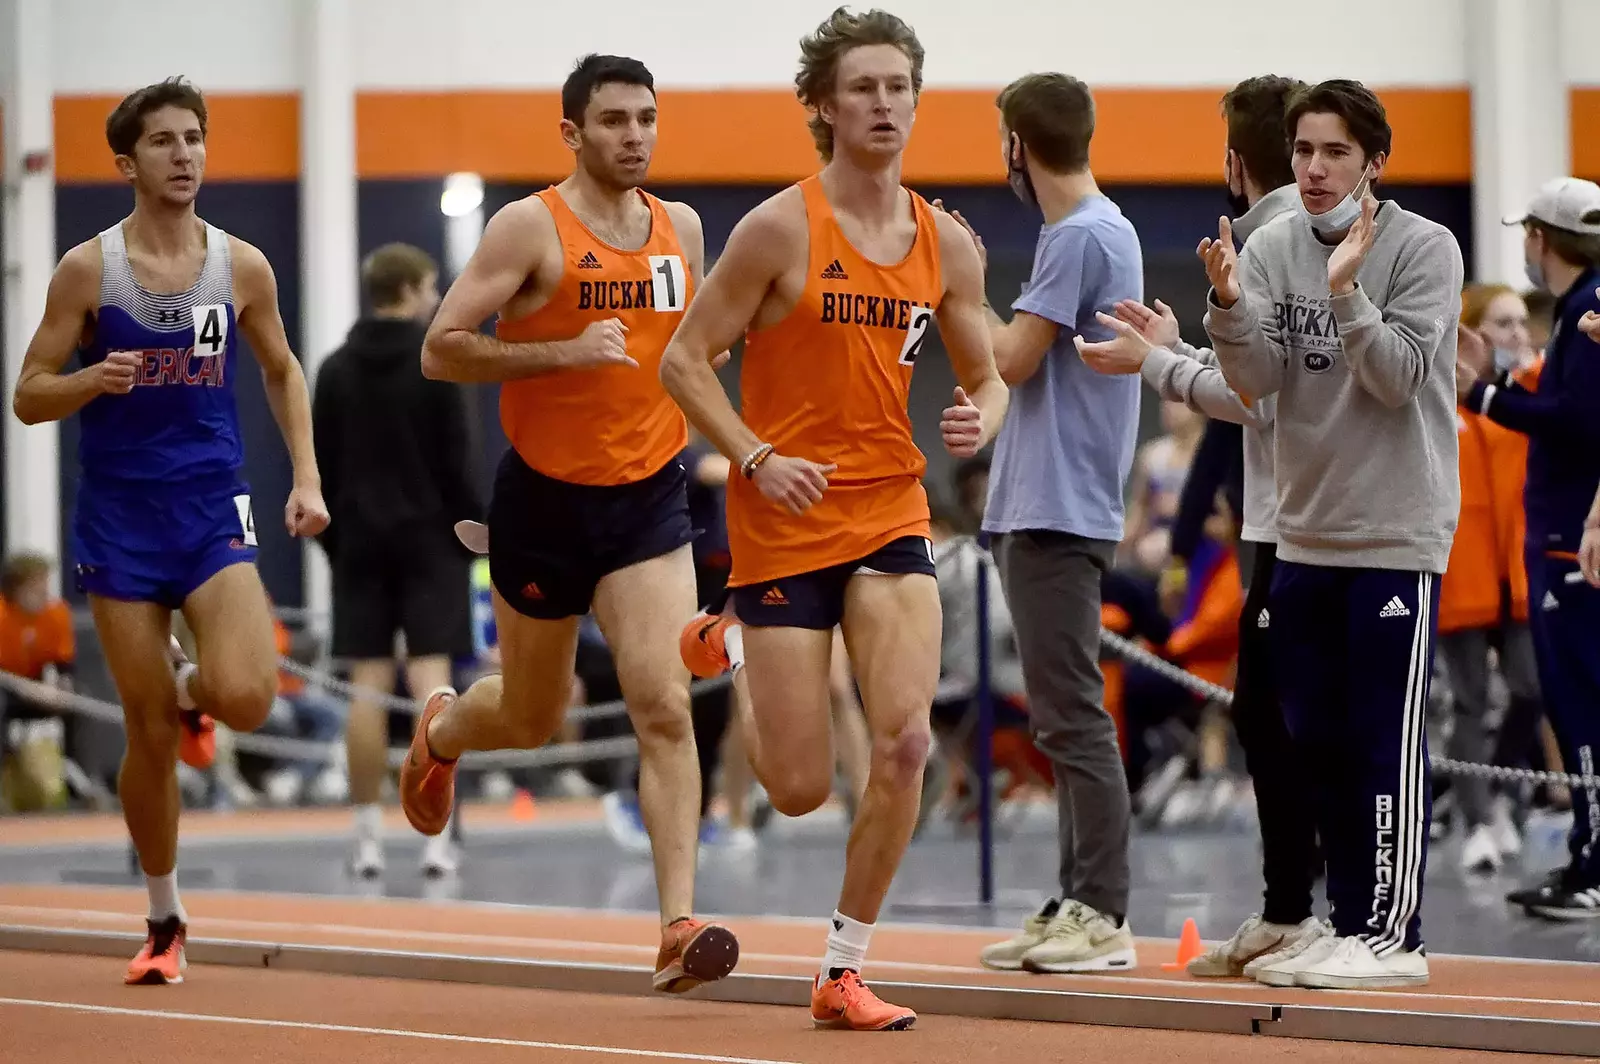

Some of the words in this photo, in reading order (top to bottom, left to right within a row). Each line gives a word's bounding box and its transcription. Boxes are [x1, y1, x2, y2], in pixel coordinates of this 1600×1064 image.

[656, 259, 676, 307] 1
[199, 308, 223, 352] 4
[821, 292, 931, 331] BUCKNE
[903, 312, 931, 362] 2
[107, 345, 227, 388] ERICAN
[1379, 607, 1411, 618] adidas
[1365, 794, 1393, 930] BUCKNELL
